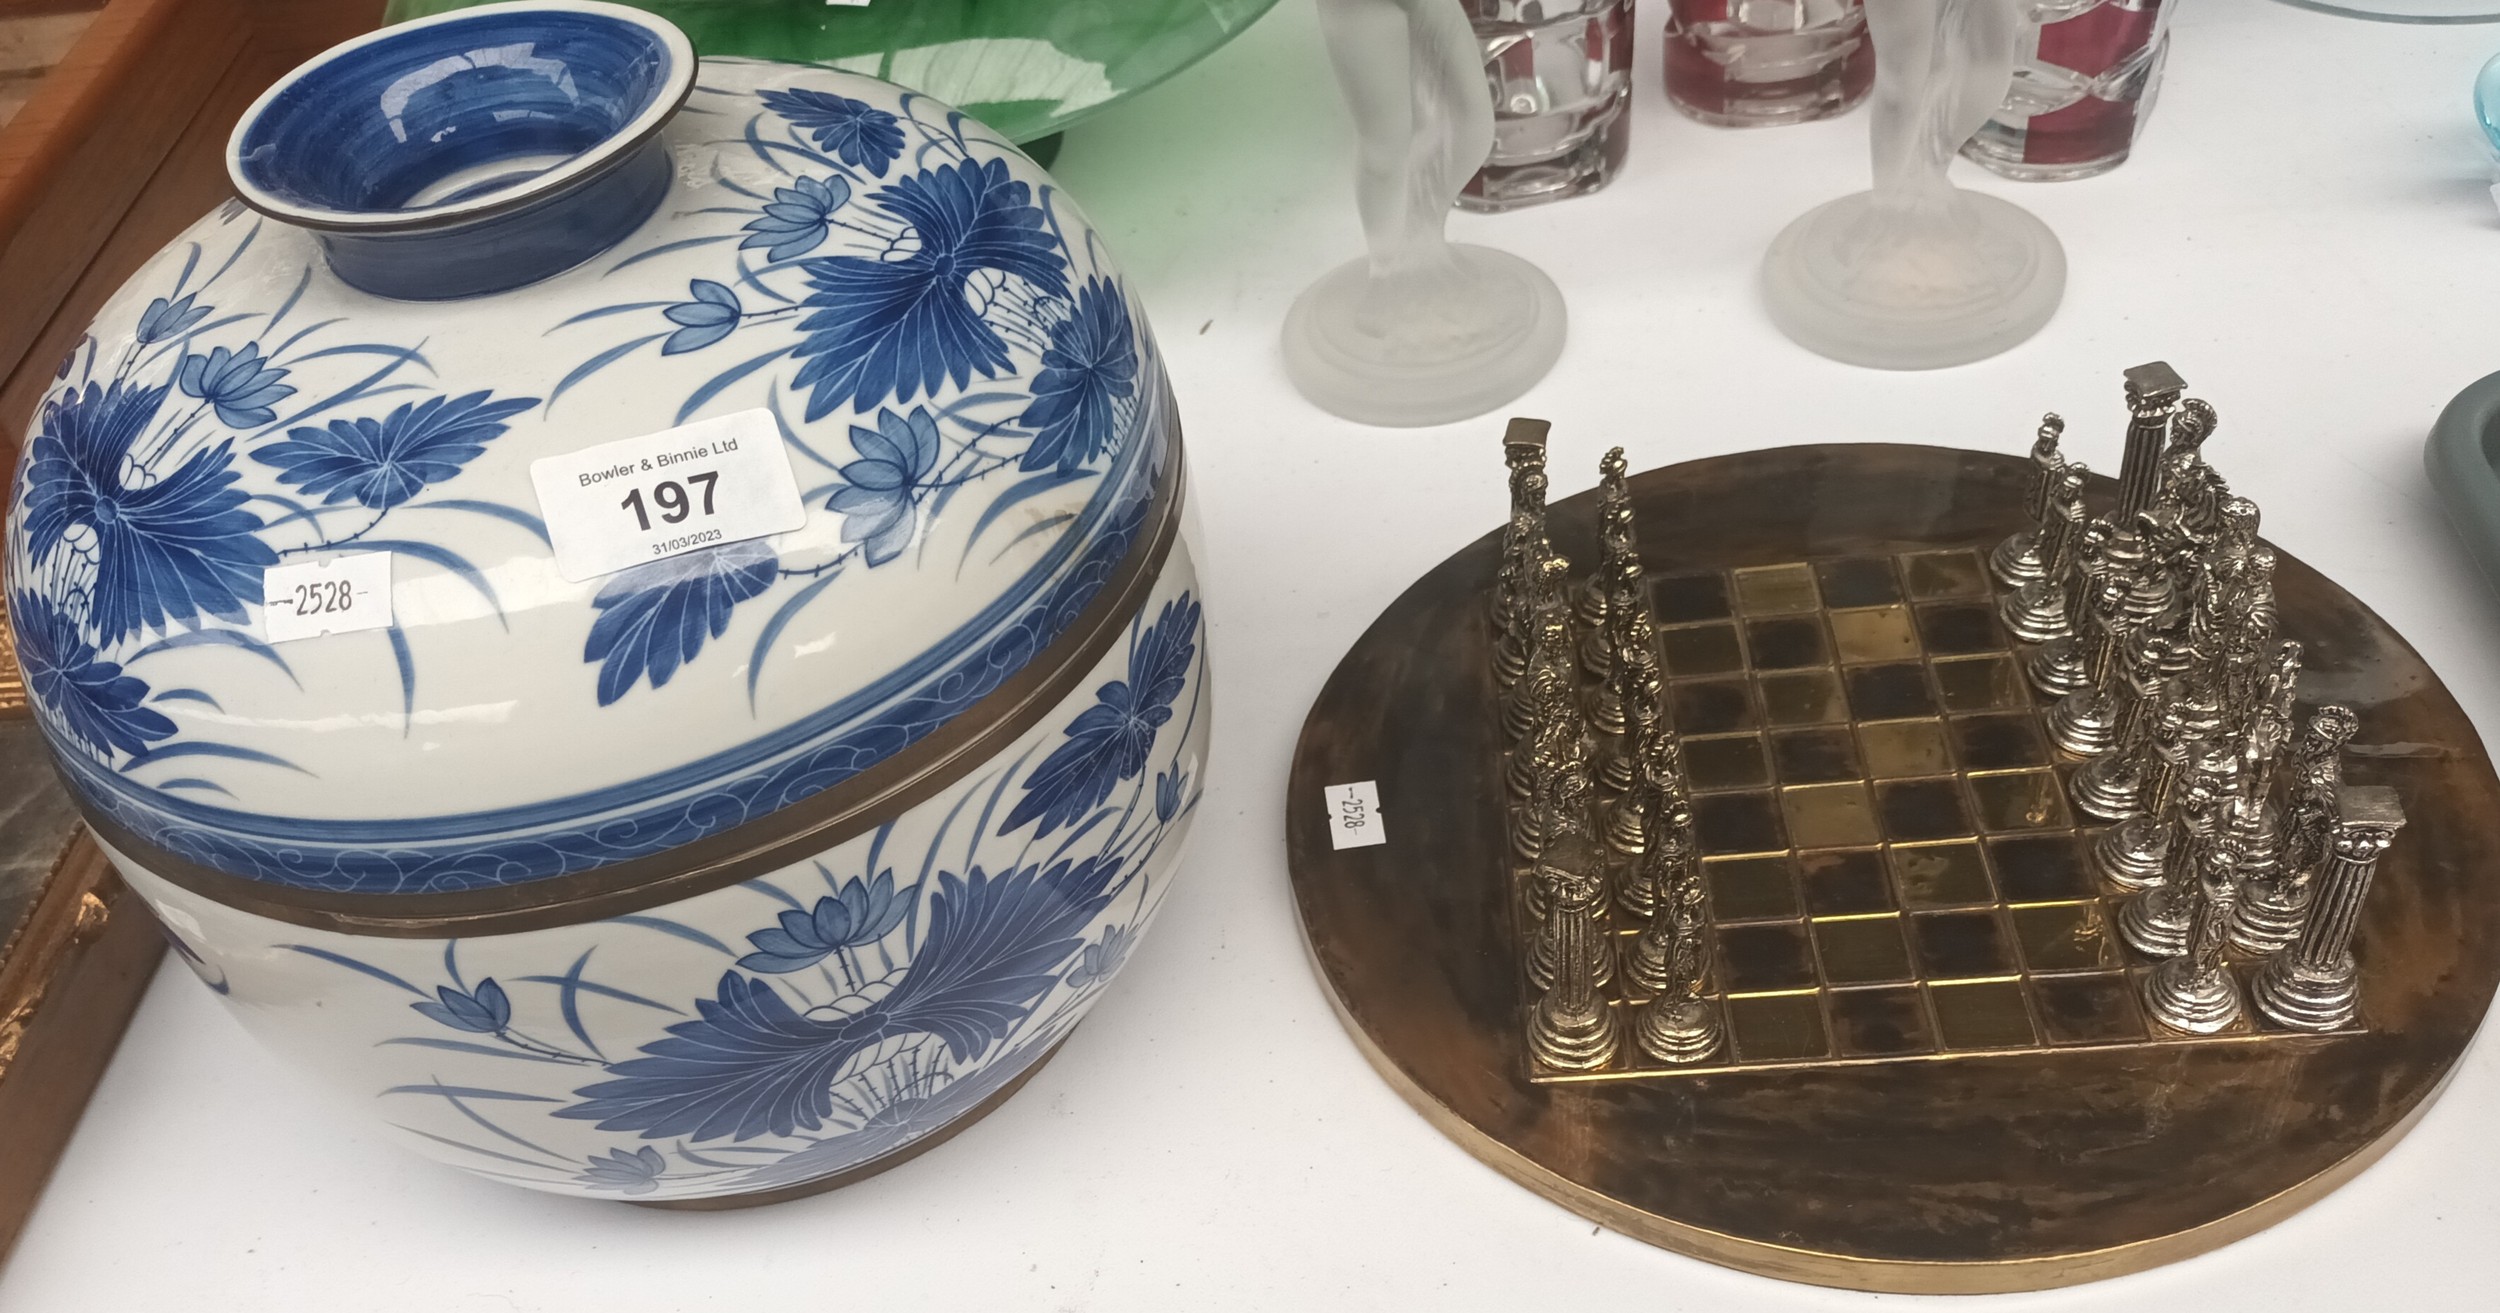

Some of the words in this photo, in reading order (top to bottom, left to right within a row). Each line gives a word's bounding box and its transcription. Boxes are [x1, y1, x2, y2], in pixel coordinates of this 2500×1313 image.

[578, 462, 635, 487] Bowler
[640, 458, 653, 472] &
[656, 446, 708, 468] Binnie
[711, 437, 739, 455] Ltd
[620, 470, 719, 531] 197
[652, 529, 722, 555] 31/03/2023
